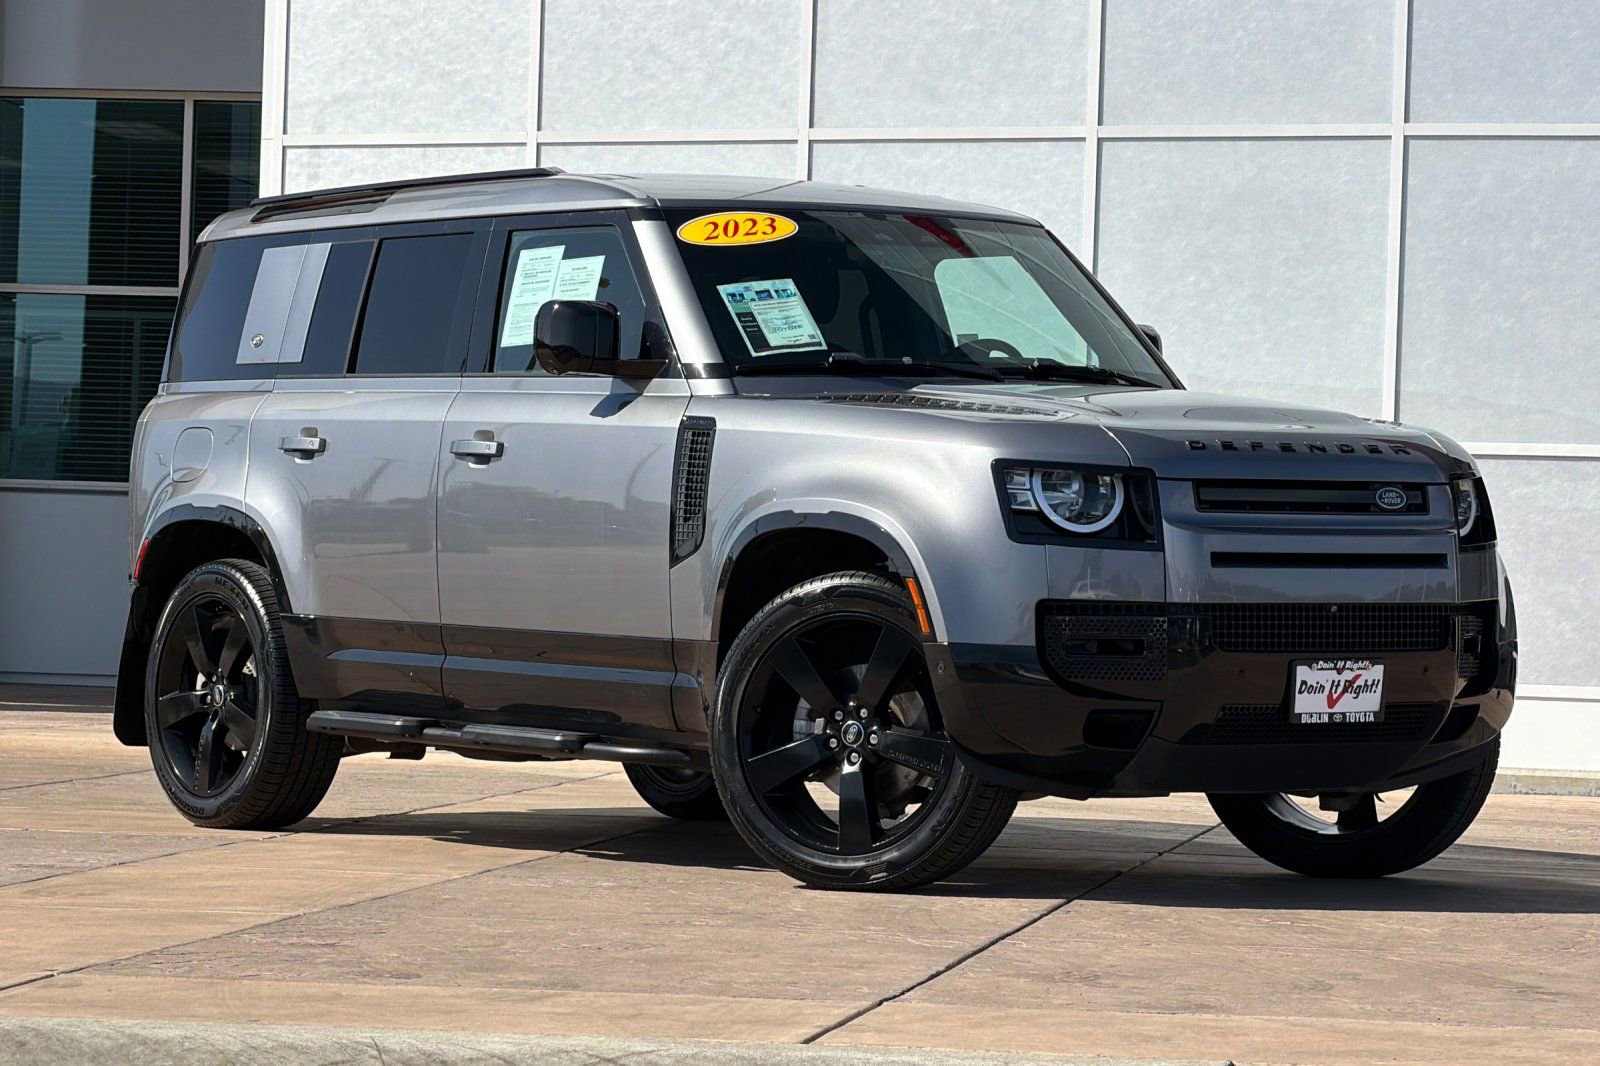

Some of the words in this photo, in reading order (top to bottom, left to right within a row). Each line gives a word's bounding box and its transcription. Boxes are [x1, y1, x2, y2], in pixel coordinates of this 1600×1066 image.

[704, 217, 777, 241] 2023
[1185, 439, 1411, 456] DEFENDER
[1318, 661, 1336, 669] Doin'
[1336, 660, 1344, 669] It
[1345, 660, 1369, 671] Right!
[1298, 679, 1328, 695] Doin'
[1329, 679, 1341, 695] It
[1343, 679, 1380, 700] Right!
[1301, 713, 1329, 723] DUBLIN
[1345, 712, 1375, 722] TOYOTA
